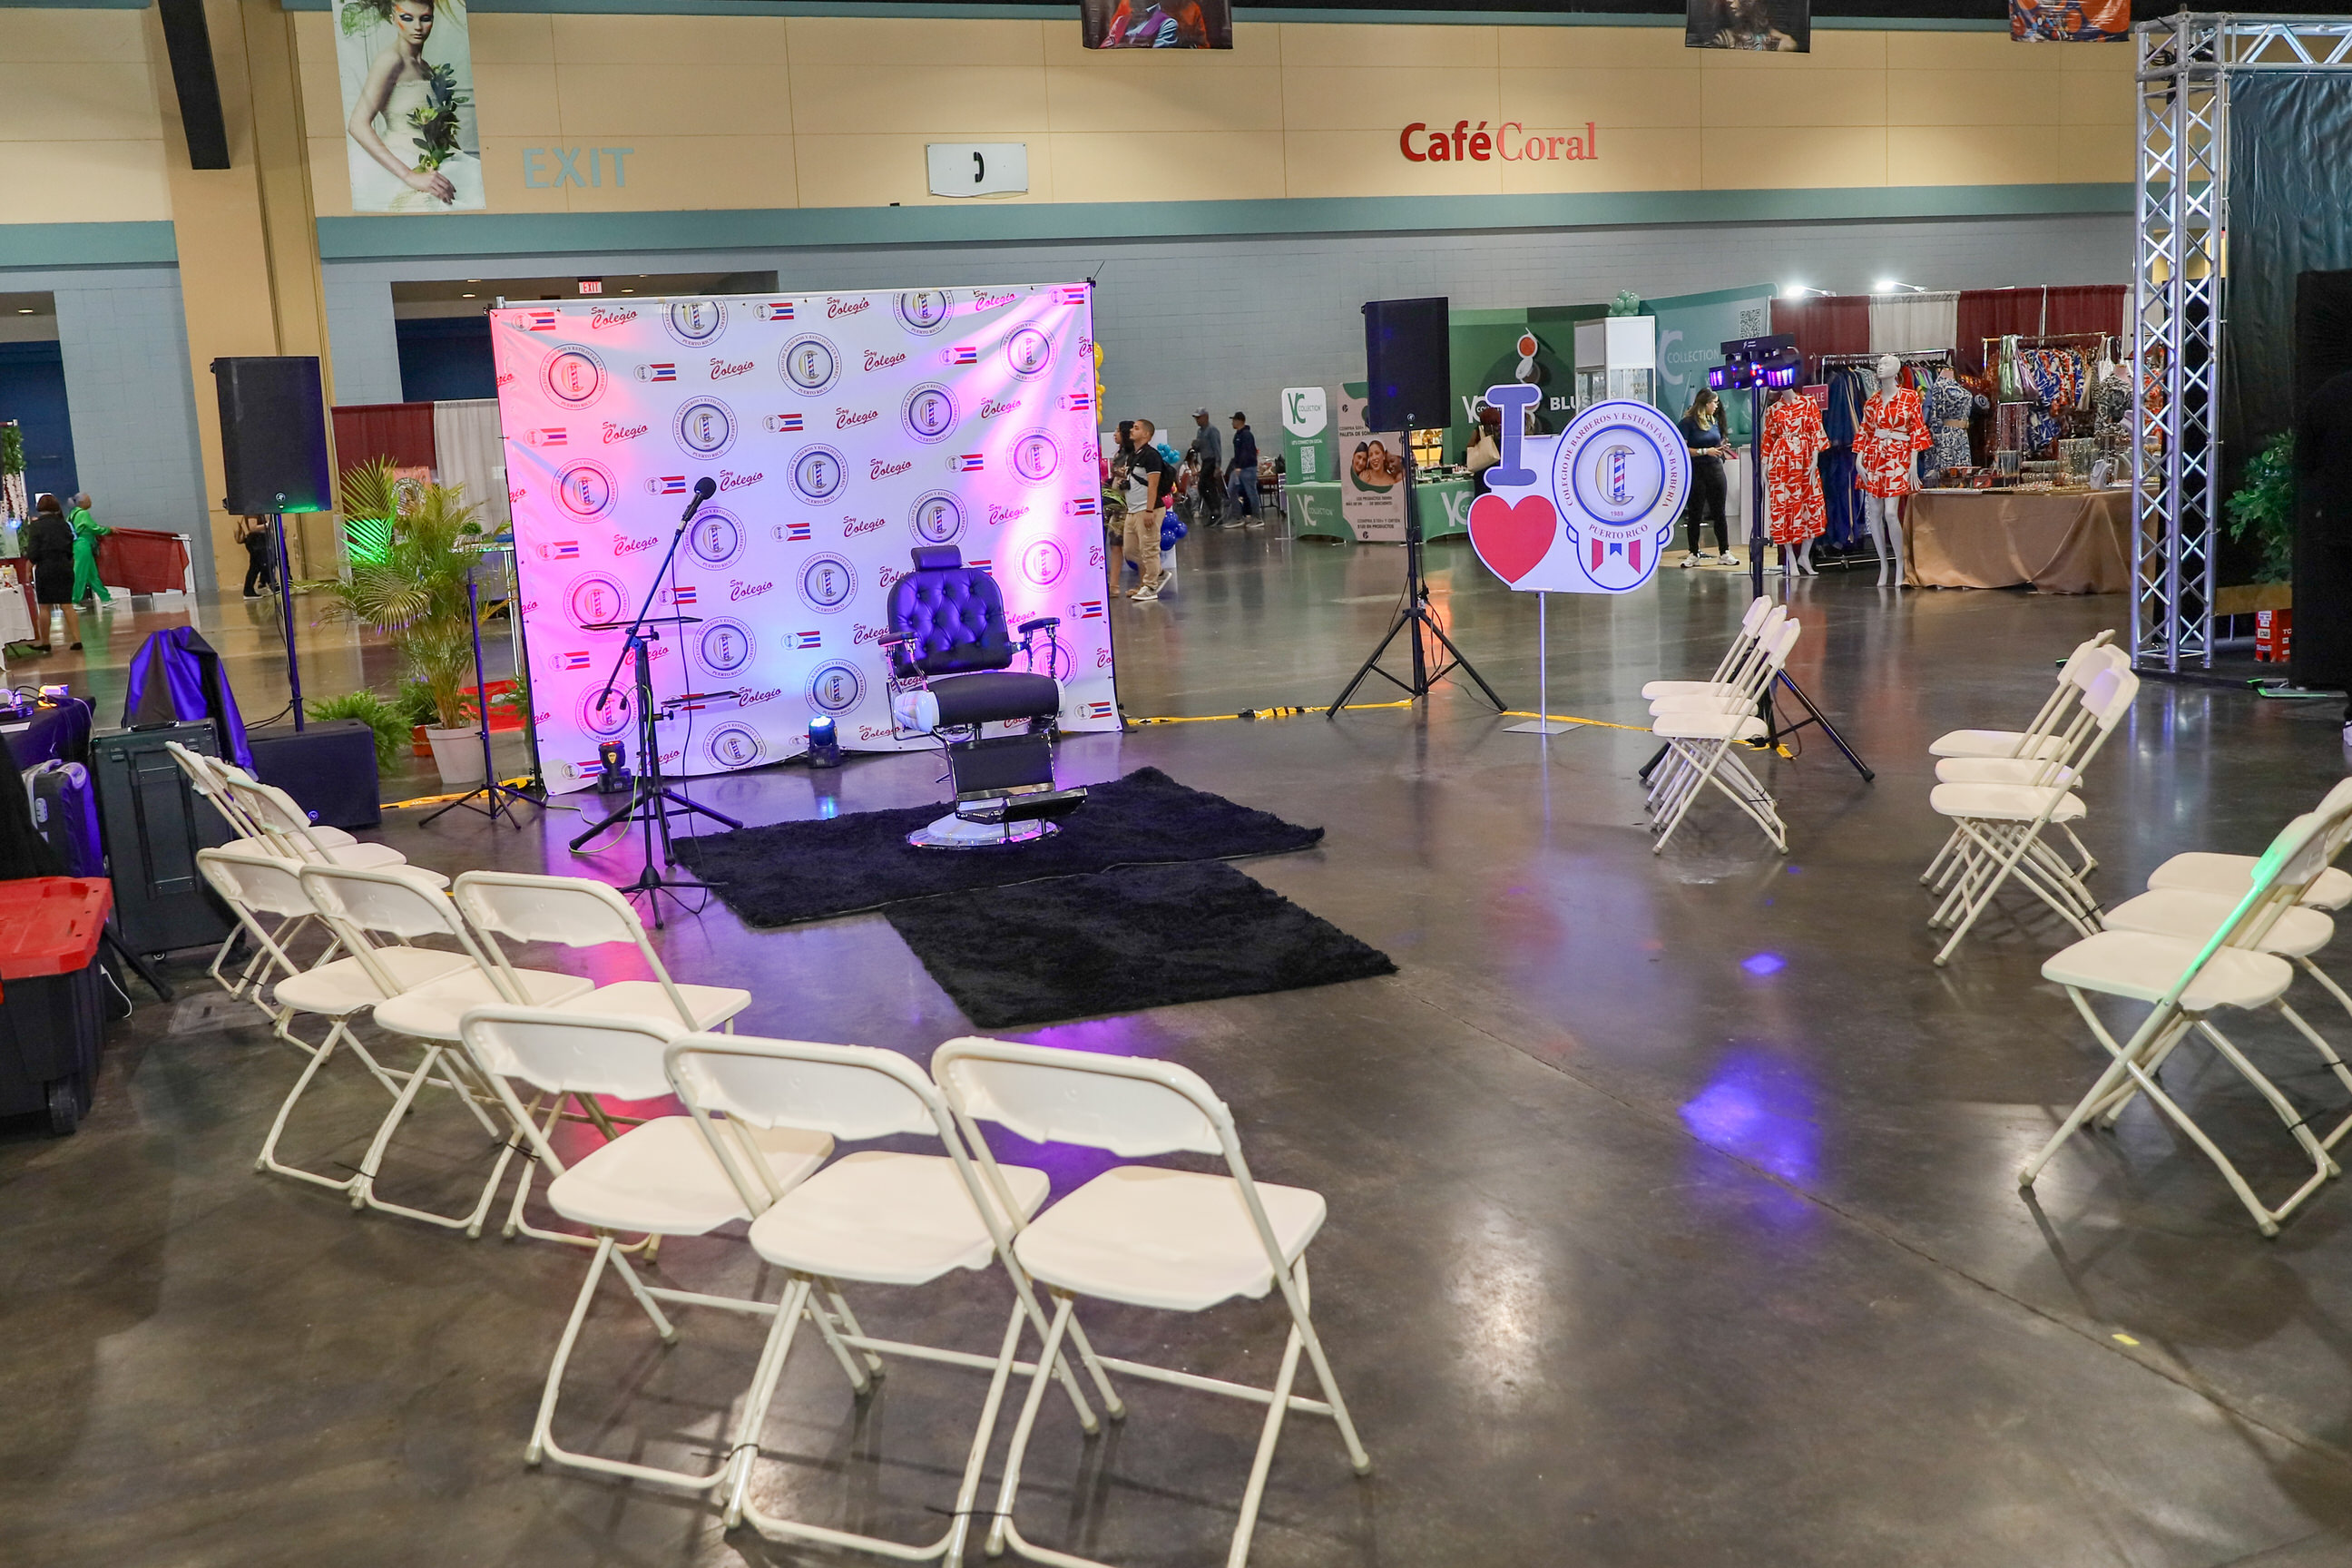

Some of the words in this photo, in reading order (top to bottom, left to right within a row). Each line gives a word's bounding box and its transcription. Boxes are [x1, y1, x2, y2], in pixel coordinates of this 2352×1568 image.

[1400, 121, 1492, 162] Café
[1497, 122, 1598, 161] Coral
[523, 148, 634, 189] EXIT
[583, 281, 600, 292] EXIT
[827, 297, 840, 305] Soy
[828, 299, 870, 320] Colegio
[591, 307, 605, 315] Soy
[592, 309, 638, 331] Colegio
[710, 358, 724, 366] Soy
[865, 352, 906, 373] Colegio
[1667, 348, 1720, 364] COLLECTION
[710, 360, 755, 381] Colegio
[981, 400, 1022, 419] Colegio
[603, 421, 616, 429] Soy
[837, 410, 879, 430] Colegio
[1622, 412, 1667, 443] ESTILISTAS
[603, 424, 649, 445] Colegio
[1485, 386, 1539, 486] I
[1571, 414, 1612, 447] BARBEROS
[1564, 447, 1573, 460] DE
[1664, 443, 1674, 456] EN
[720, 469, 733, 477] Soy
[870, 461, 912, 480] Colegio
[720, 472, 764, 492] Colegio
[1562, 462, 1573, 506] COLEGIO
[989, 506, 1031, 524] Colegio
[844, 518, 886, 537] Colegio
[1589, 524, 1623, 539] PUERTO
[1626, 524, 1648, 538] RICO
[614, 536, 659, 556] Colegio
[730, 582, 774, 601] Colegio
[1007, 611, 1035, 627] olegio
[854, 625, 889, 644] Colegi
[740, 689, 781, 707] Colegio
